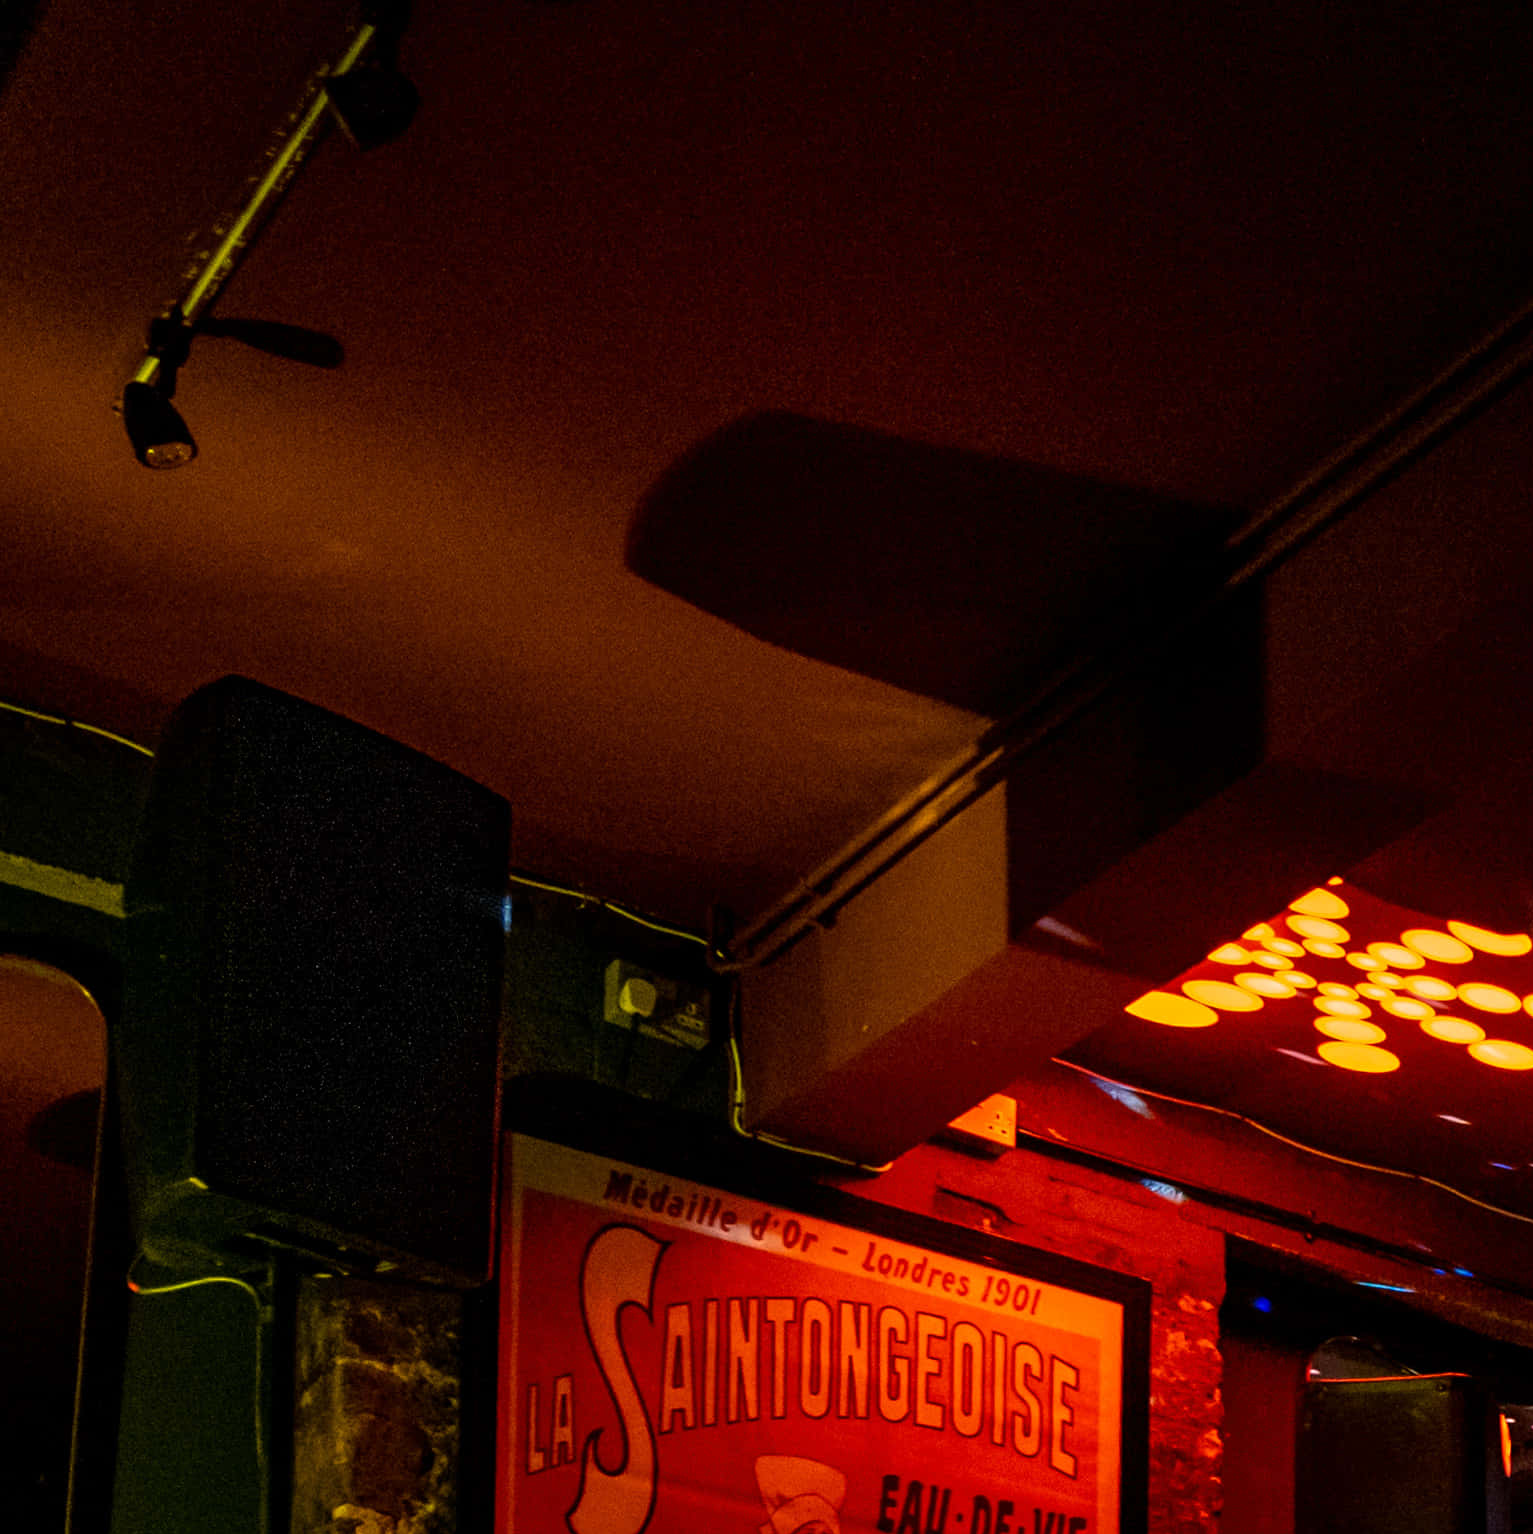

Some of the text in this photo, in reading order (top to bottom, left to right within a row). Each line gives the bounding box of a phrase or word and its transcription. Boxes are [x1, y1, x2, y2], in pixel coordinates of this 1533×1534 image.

[751, 1211, 820, 1256] d'Or
[861, 1242, 970, 1299] Londres
[981, 1275, 1044, 1316] 1901
[526, 1374, 575, 1475] LA
